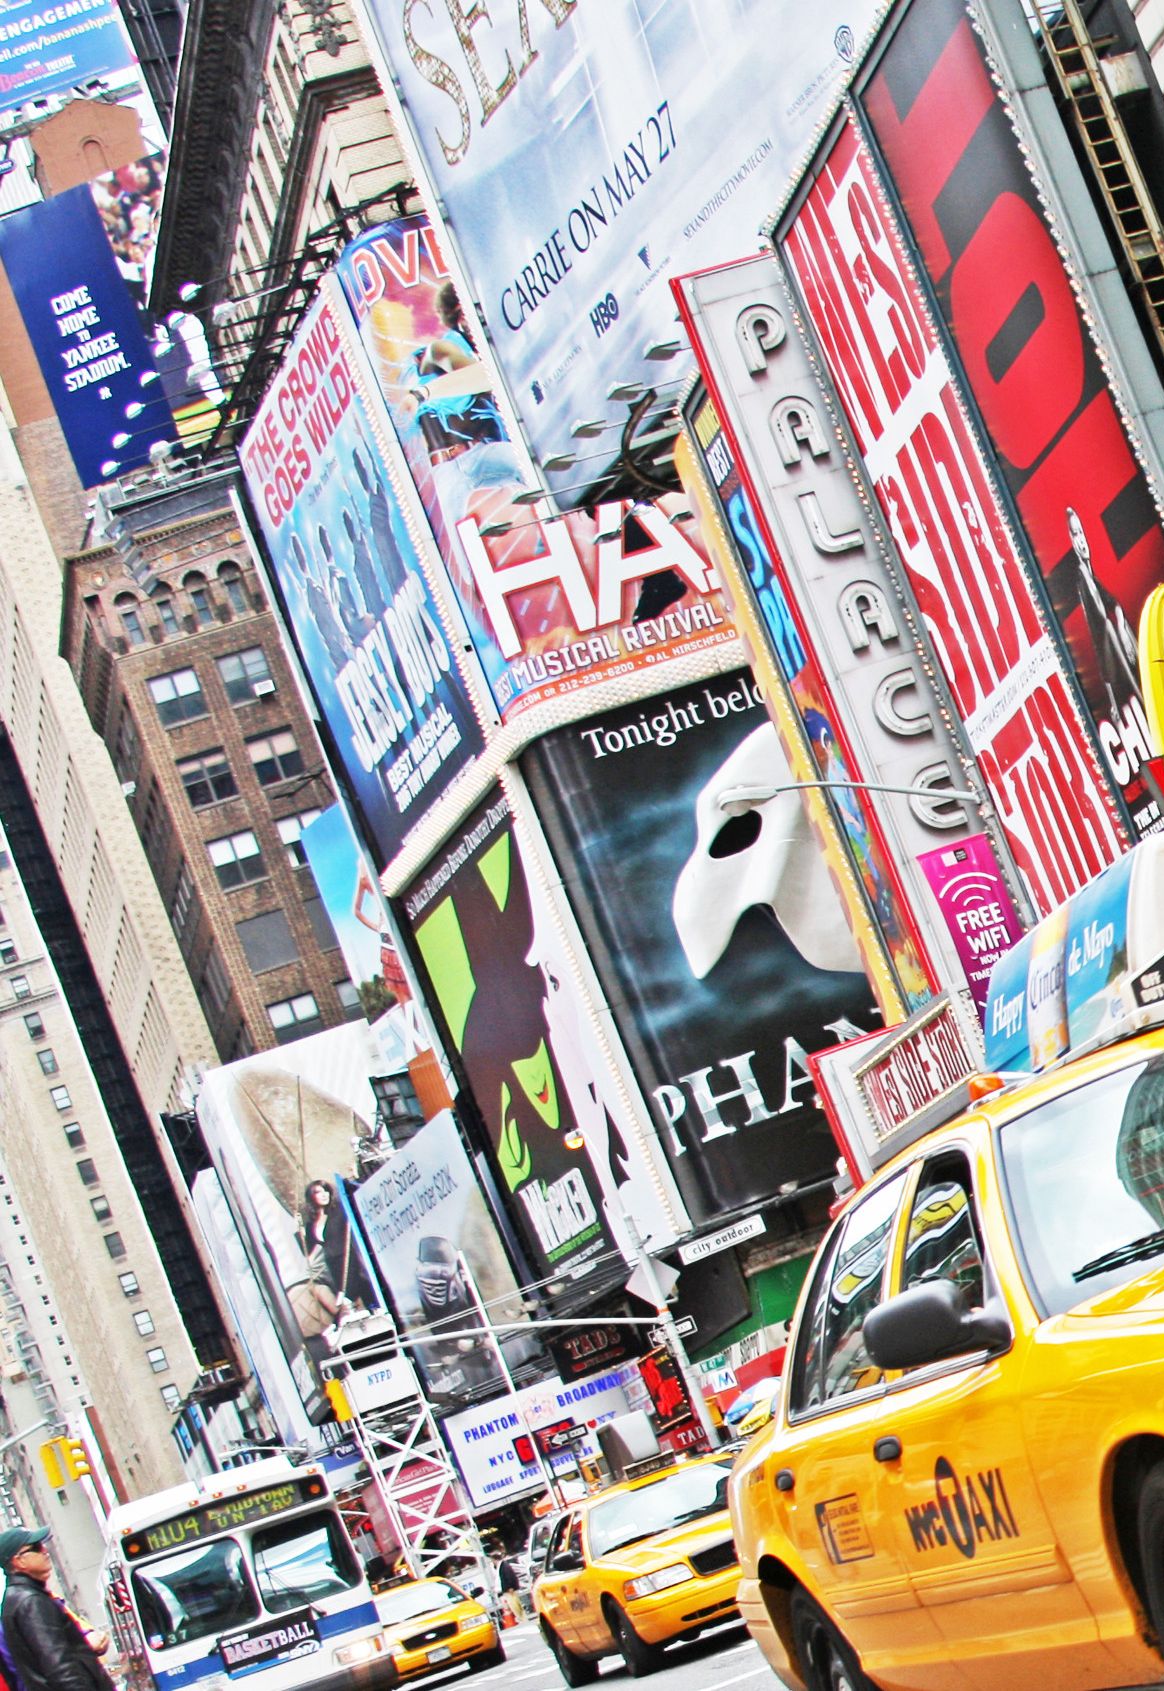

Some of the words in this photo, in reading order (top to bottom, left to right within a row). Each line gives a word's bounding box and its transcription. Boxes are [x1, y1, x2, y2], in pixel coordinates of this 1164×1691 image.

[0, 0, 114, 42] ENGAGEMEN
[403, 0, 578, 167] SE
[501, 229, 573, 332] CARRIE
[567, 196, 610, 255] ON
[603, 130, 653, 220] MAY
[647, 100, 678, 163] 27
[51, 285, 92, 315] COME
[56, 306, 100, 337] HOME
[589, 292, 619, 338] HBO
[61, 332, 120, 369] YANKEE
[77, 329, 91, 342] TO
[63, 351, 132, 392] STADIUM.
[277, 303, 341, 433] CROWD
[263, 433, 312, 528] GOES
[735, 301, 971, 832] PALACE
[384, 569, 451, 708] BOYS
[512, 634, 620, 690] MUSICAL
[621, 601, 724, 652] REVIVAL
[559, 661, 636, 692] 212-239-6200
[671, 628, 737, 656] HIRSCHFELD
[386, 749, 415, 794] BEST
[408, 701, 454, 765] MUSICAL
[581, 701, 706, 760] Tonight
[955, 901, 1006, 935] FREE
[966, 927, 1011, 955] WIFI
[980, 949, 999, 966] NOW
[991, 990, 1026, 1040] Happy
[1067, 937, 1083, 978] de
[1083, 918, 1115, 969] Mayo
[692, 1242, 711, 1258] city
[715, 1223, 755, 1246] outdoor
[366, 1369, 393, 1386] NYPD
[463, 1412, 520, 1444] PHANTOM
[556, 1370, 628, 1409] BROADWAY
[488, 1450, 516, 1468] NYC
[482, 1474, 514, 1495] LUGGAGE
[225, 1620, 315, 1666] BASKETBALL
